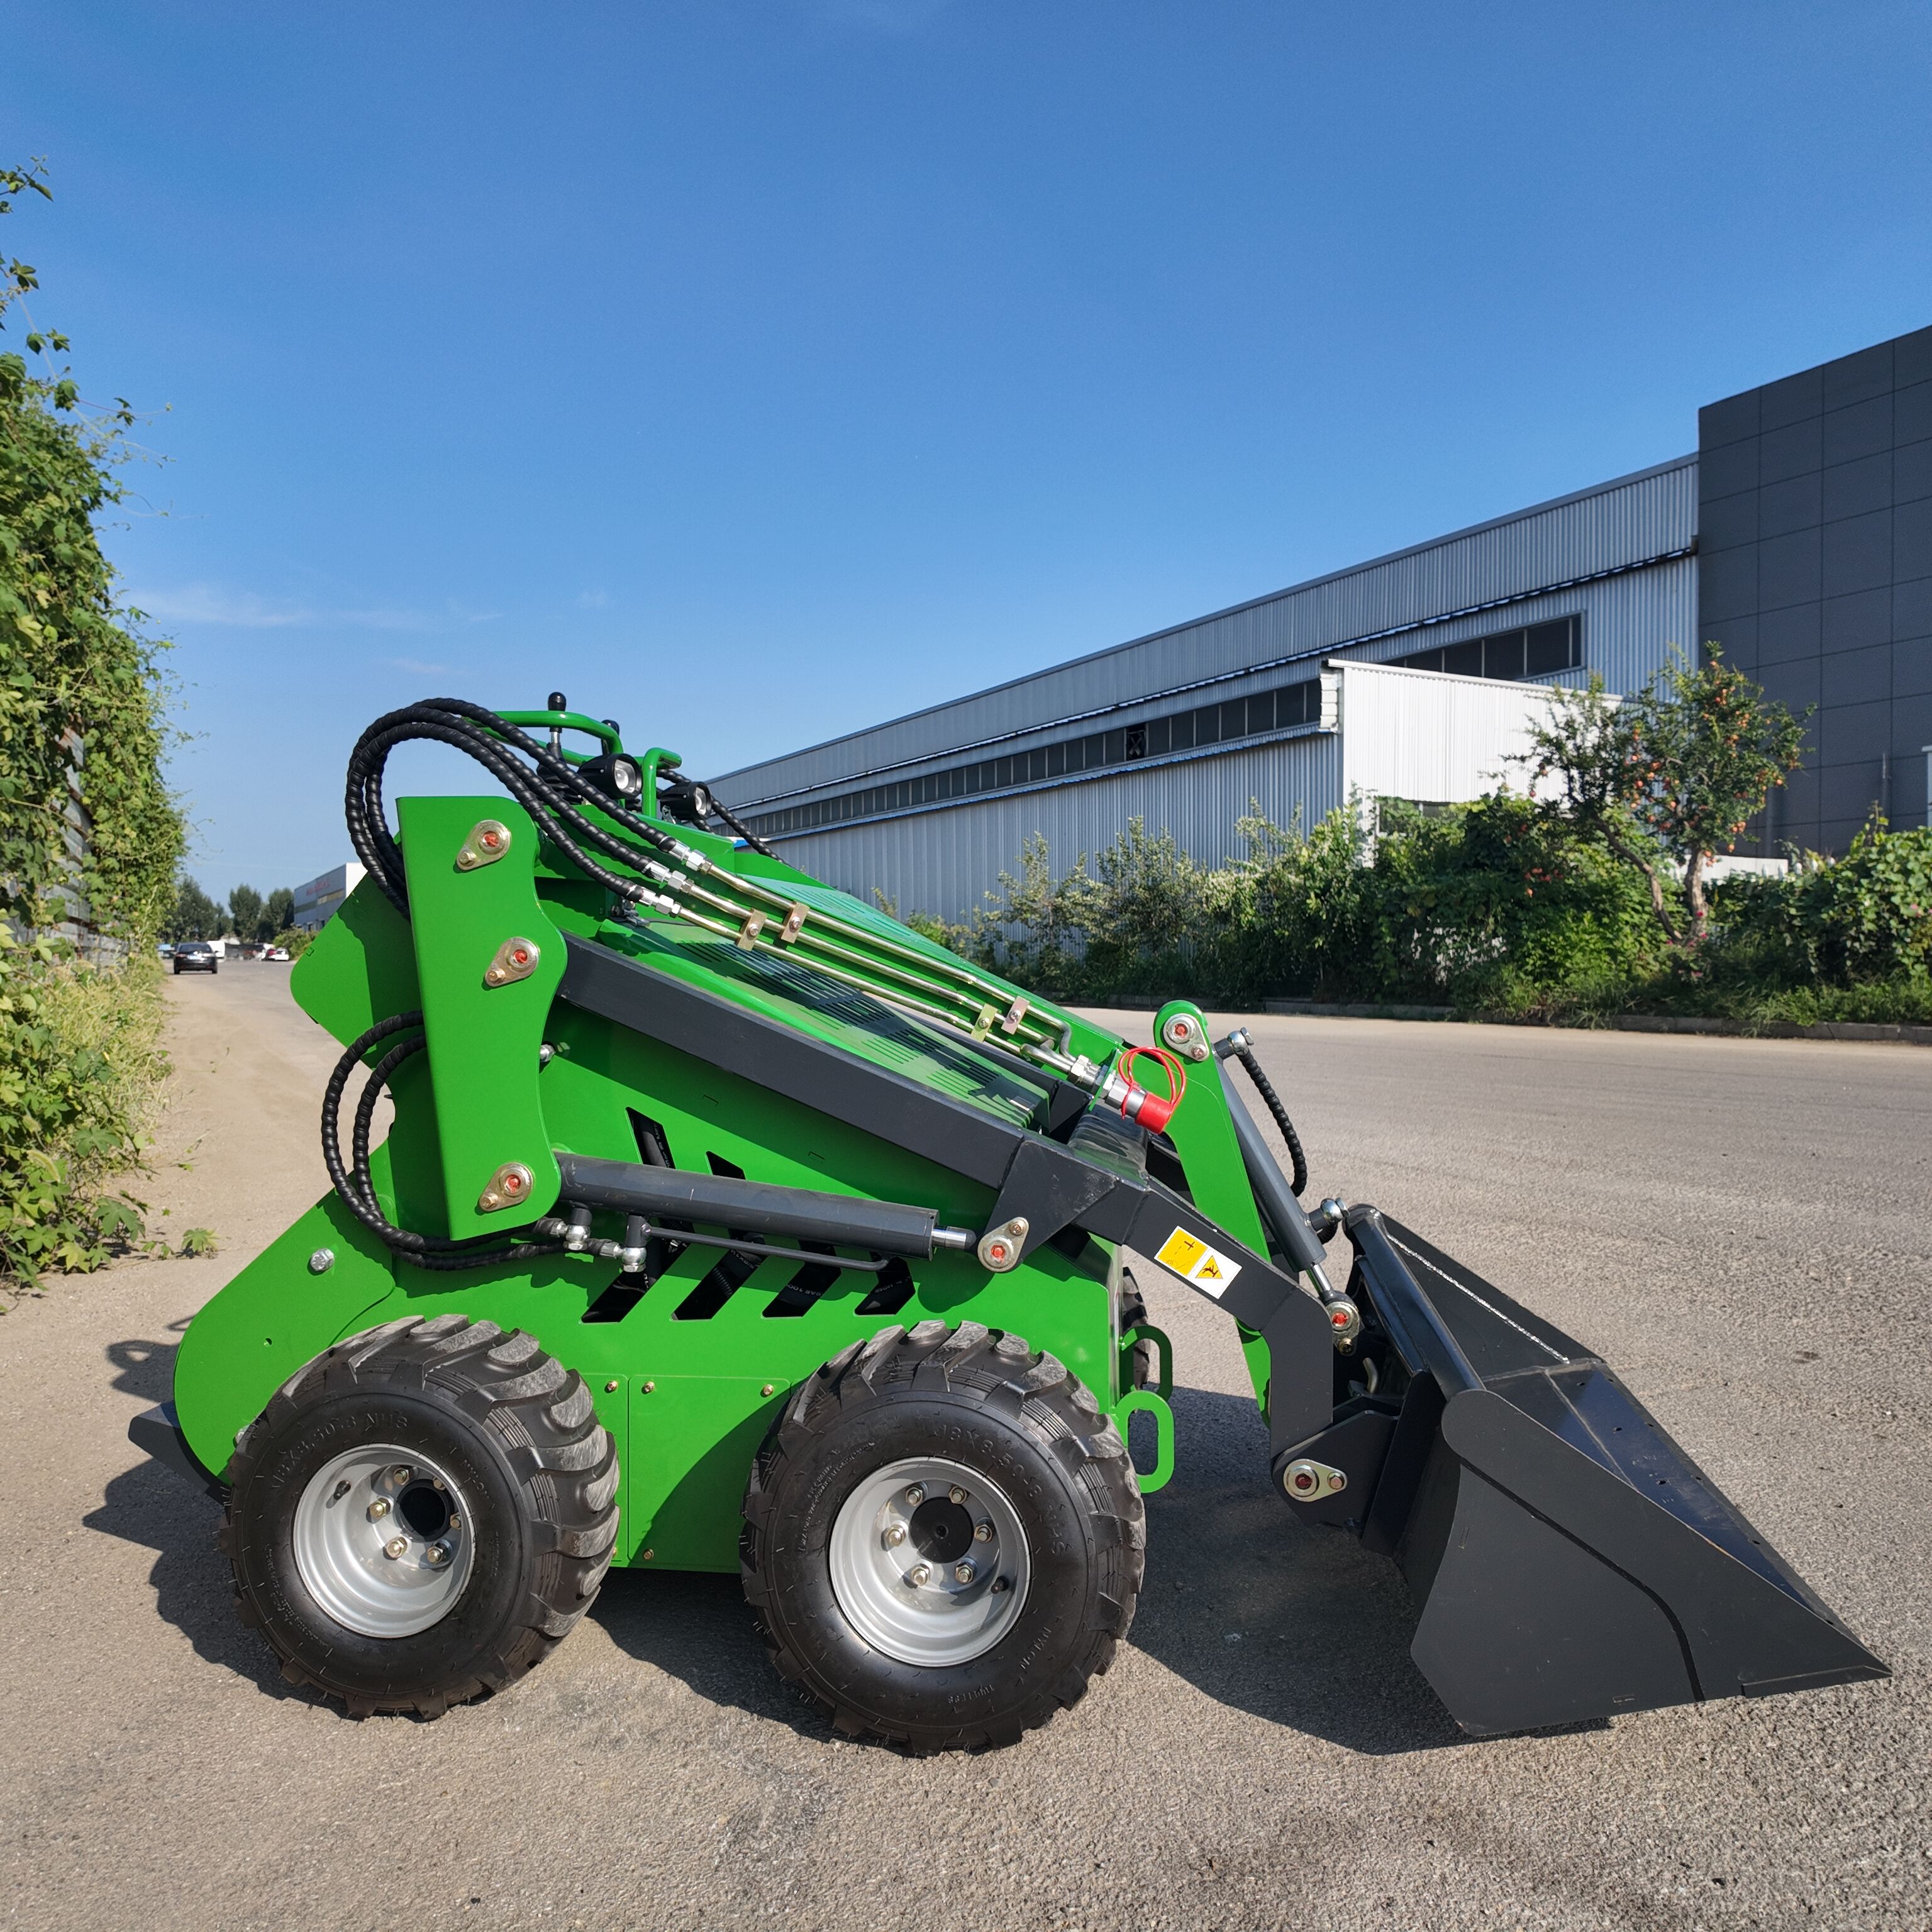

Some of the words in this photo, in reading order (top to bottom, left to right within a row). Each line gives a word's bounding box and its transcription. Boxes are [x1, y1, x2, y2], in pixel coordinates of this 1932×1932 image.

[786, 1284, 803, 1292] 100
[367, 1413, 408, 1430] NHS
[1019, 1626, 1052, 1670] NYLON
